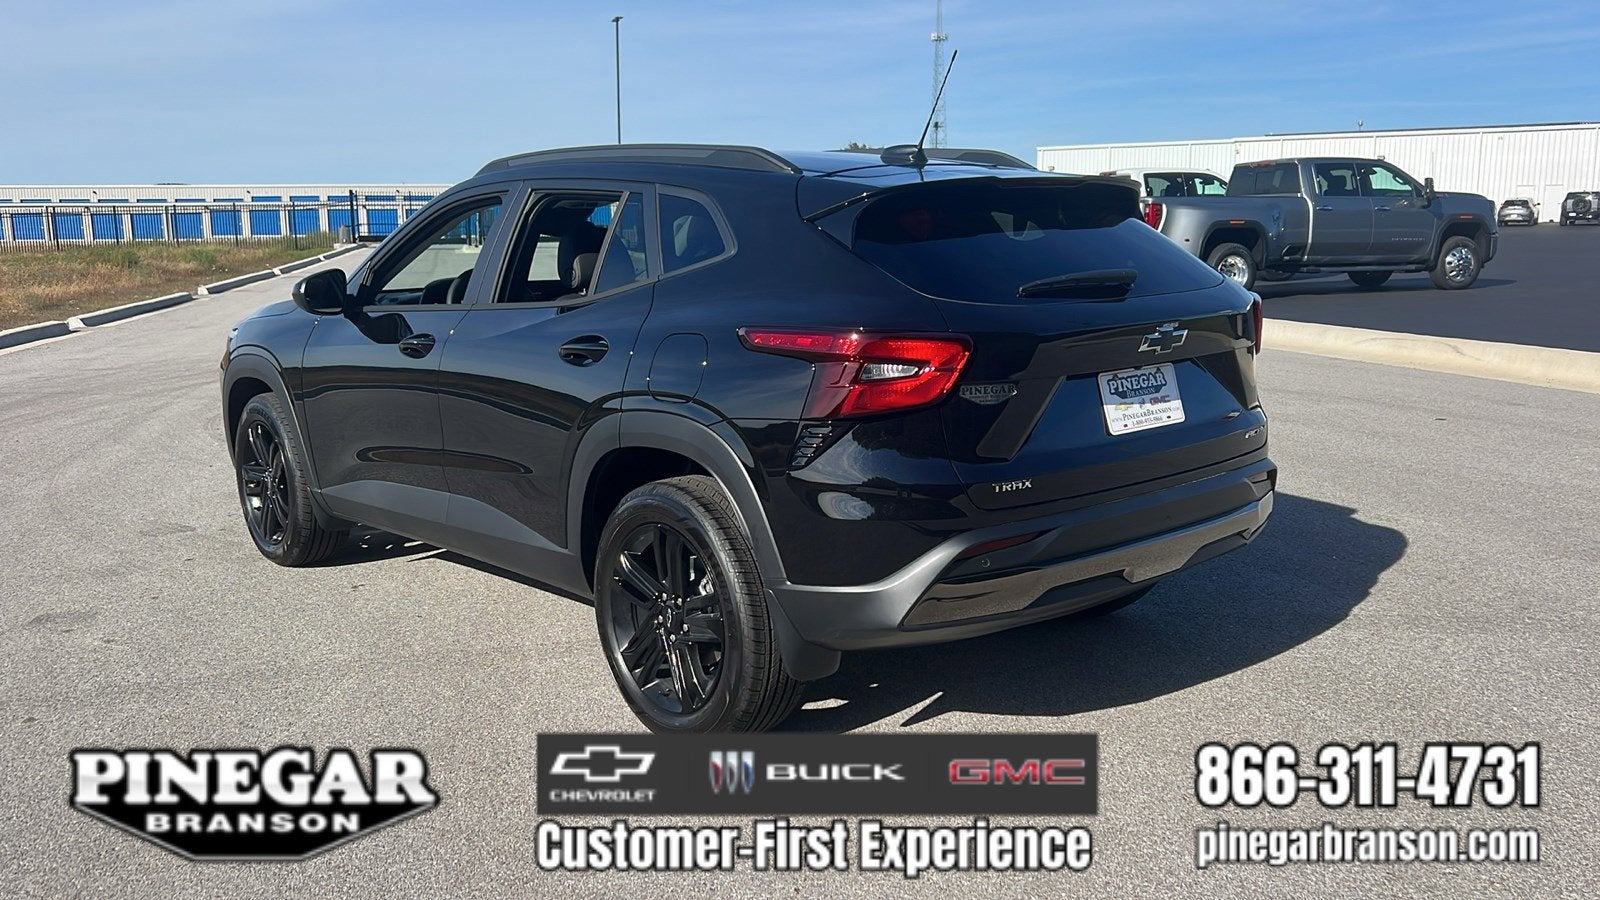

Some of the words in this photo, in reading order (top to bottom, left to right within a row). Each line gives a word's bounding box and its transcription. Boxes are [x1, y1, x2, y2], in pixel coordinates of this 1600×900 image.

[1108, 373, 1166, 393] PINEGAR
[961, 385, 1016, 396] PINEGAR
[1126, 388, 1156, 398] BRANSON
[991, 479, 1032, 493] TRAX
